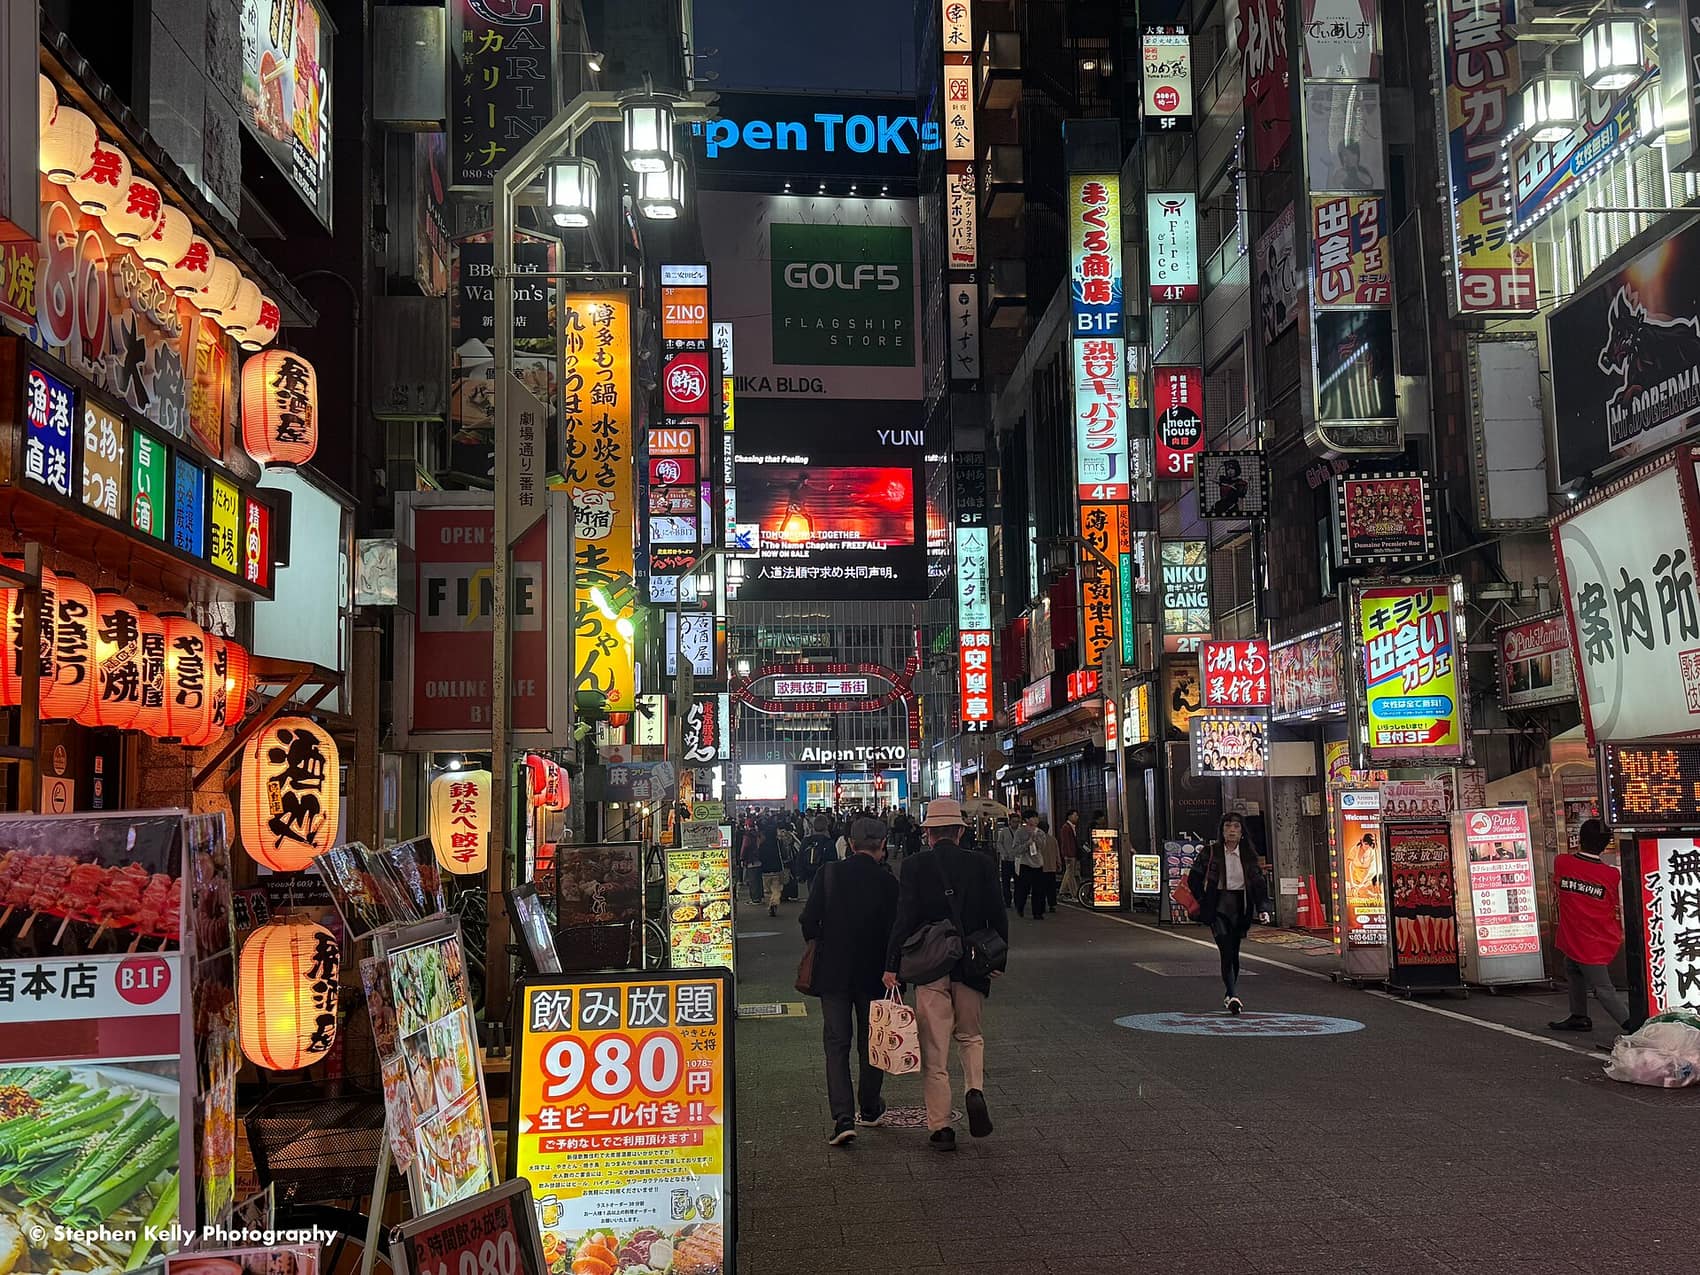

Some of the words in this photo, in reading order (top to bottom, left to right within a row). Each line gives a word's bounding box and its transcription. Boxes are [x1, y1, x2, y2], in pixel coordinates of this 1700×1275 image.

[963, 56, 969, 64] 7
[462, 29, 474, 166] 個室ダイニング
[476, 29, 506, 167] カリーナ
[950, 113, 970, 149] 魚金
[1160, 118, 1176, 128] 5F
[966, 165, 972, 173] 6
[1081, 182, 1113, 304] まぐろ商店
[1360, 200, 1382, 272] カフェ
[1169, 221, 1179, 271] Fire
[1317, 200, 1354, 302] 出会い
[784, 263, 900, 290] GOLF5
[969, 274, 975, 282] 5
[1163, 287, 1185, 300] 4F
[1364, 286, 1388, 302] 1F
[1462, 274, 1531, 307] 3F
[666, 306, 705, 319] ZINO
[1078, 313, 1119, 330] B1F
[785, 317, 902, 329] FLAGSHIP
[830, 334, 902, 346] STORE
[590, 304, 618, 406] 博多もつ鍋
[777, 378, 827, 393] BLDG.
[27, 374, 69, 437] 漁港
[1167, 410, 1200, 429] meat
[85, 409, 118, 464] 名物
[877, 430, 925, 445] YUNI
[1163, 423, 1197, 445] house
[519, 412, 534, 506] 劇場通り一番街
[591, 413, 622, 488] 水炊き
[25, 437, 67, 496] 直送
[1168, 453, 1194, 472] 3F
[1091, 487, 1117, 499] 4F
[575, 507, 608, 528] 新宿
[961, 513, 982, 523] 3F
[441, 526, 484, 544] OPEN
[583, 527, 597, 538] の
[817, 531, 860, 539] TOGETHER
[962, 556, 976, 610] バンタイ
[1163, 567, 1207, 584] NIKU
[1164, 593, 1208, 608] GANG
[1369, 588, 1433, 631] キラリ
[1577, 549, 1700, 667] 案内所
[961, 633, 990, 646] 焼肉
[1177, 637, 1200, 652] 2F
[1370, 614, 1445, 680] 出会い
[100, 610, 139, 702] 串焼
[1403, 653, 1450, 692] カフェ
[426, 680, 487, 697] ONLINE
[777, 680, 865, 694] 歌舞伎町一番街
[965, 650, 988, 718] 安楽亭
[967, 720, 987, 731] 2F
[1378, 731, 1430, 744] 受付3F
[802, 748, 854, 763] Alpen
[450, 782, 479, 863] 鉄なべ餃子
[1492, 814, 1517, 826] Pink
[1560, 877, 1604, 898] 無料案内所
[1646, 873, 1668, 1010] ファイナルアンサー
[121, 970, 164, 989] B1F
[532, 985, 715, 1032] 飲み放題
[681, 1029, 717, 1038] やきとん
[691, 1039, 717, 1051] 大将
[543, 1033, 680, 1098] 980
[687, 1071, 712, 1093] 円
